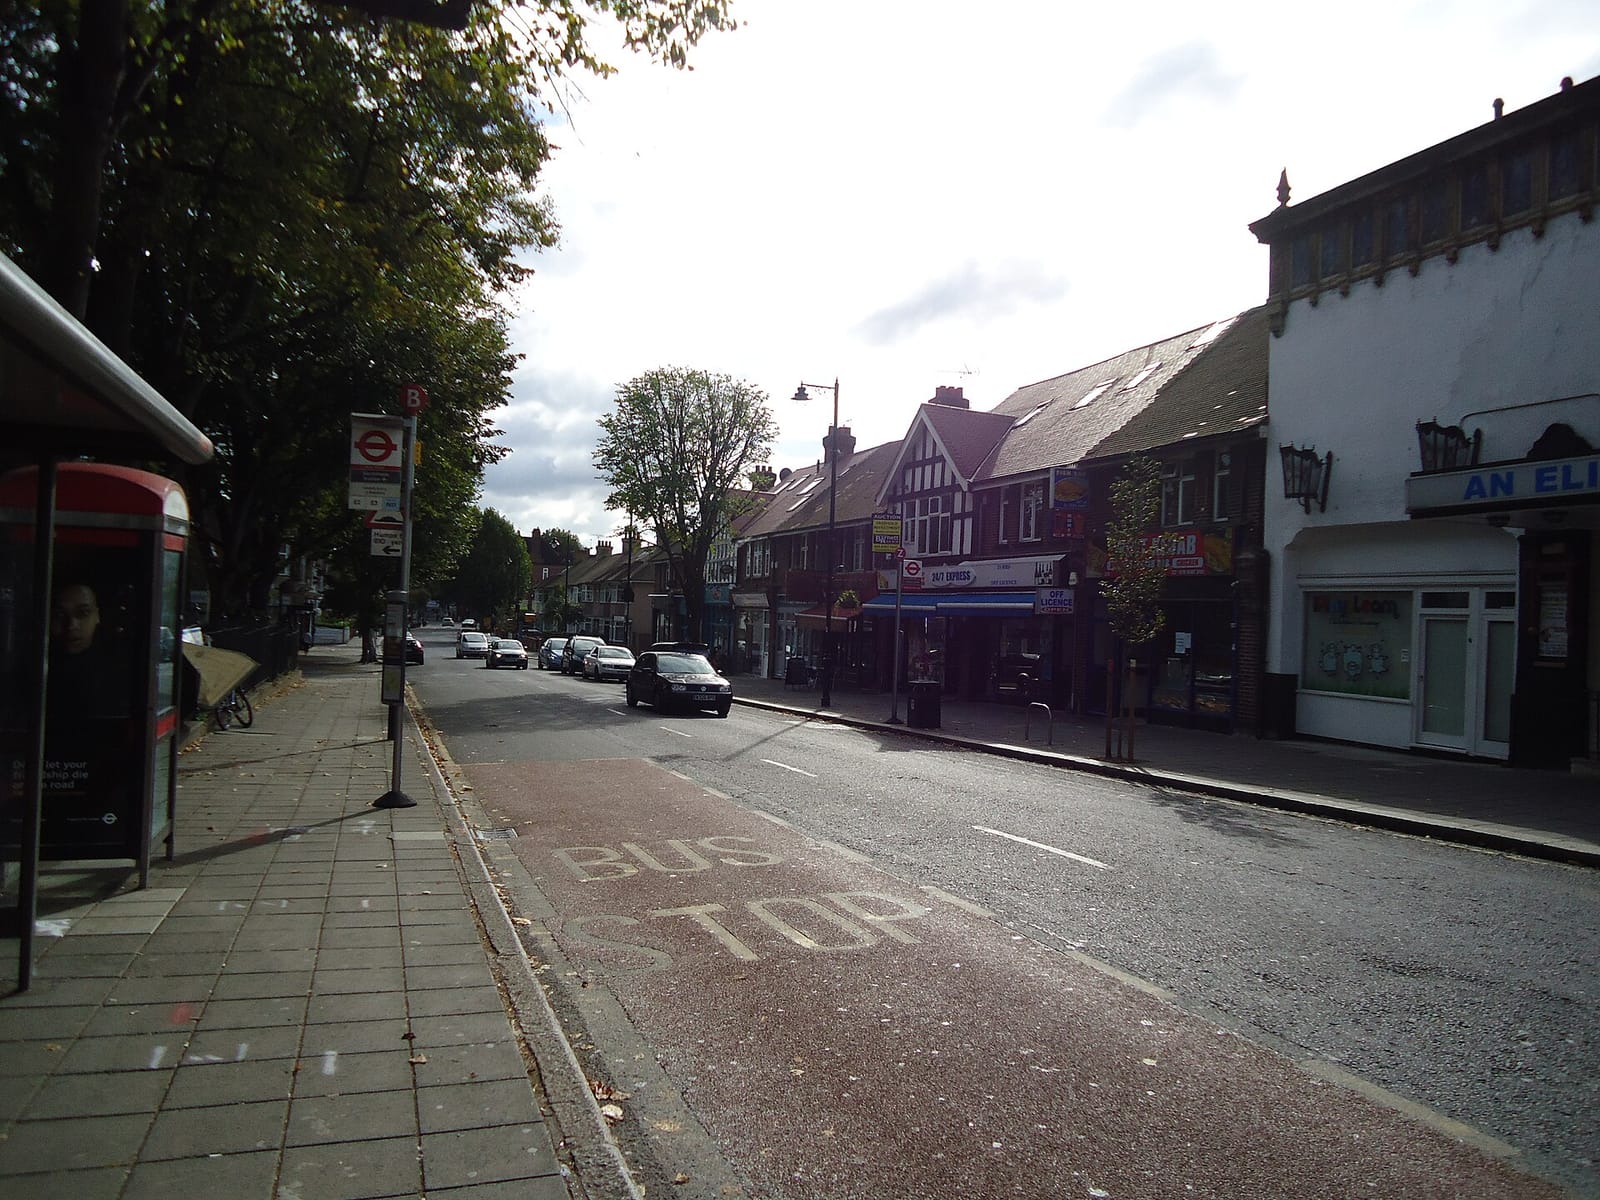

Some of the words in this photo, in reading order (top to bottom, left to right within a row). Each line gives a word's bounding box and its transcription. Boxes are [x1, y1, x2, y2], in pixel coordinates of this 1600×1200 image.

[407, 388, 421, 408] B
[1463, 471, 1515, 500] AN
[896, 549, 905, 558] Z
[931, 571, 945, 582] 24/7
[945, 570, 971, 582] EXPRESS
[1049, 590, 1065, 599] OFF
[1040, 598, 1073, 607] LICENCE
[63, 760, 87, 771] your
[71, 770, 89, 779] die
[551, 835, 784, 883] BUS
[561, 890, 931, 977] STOP
